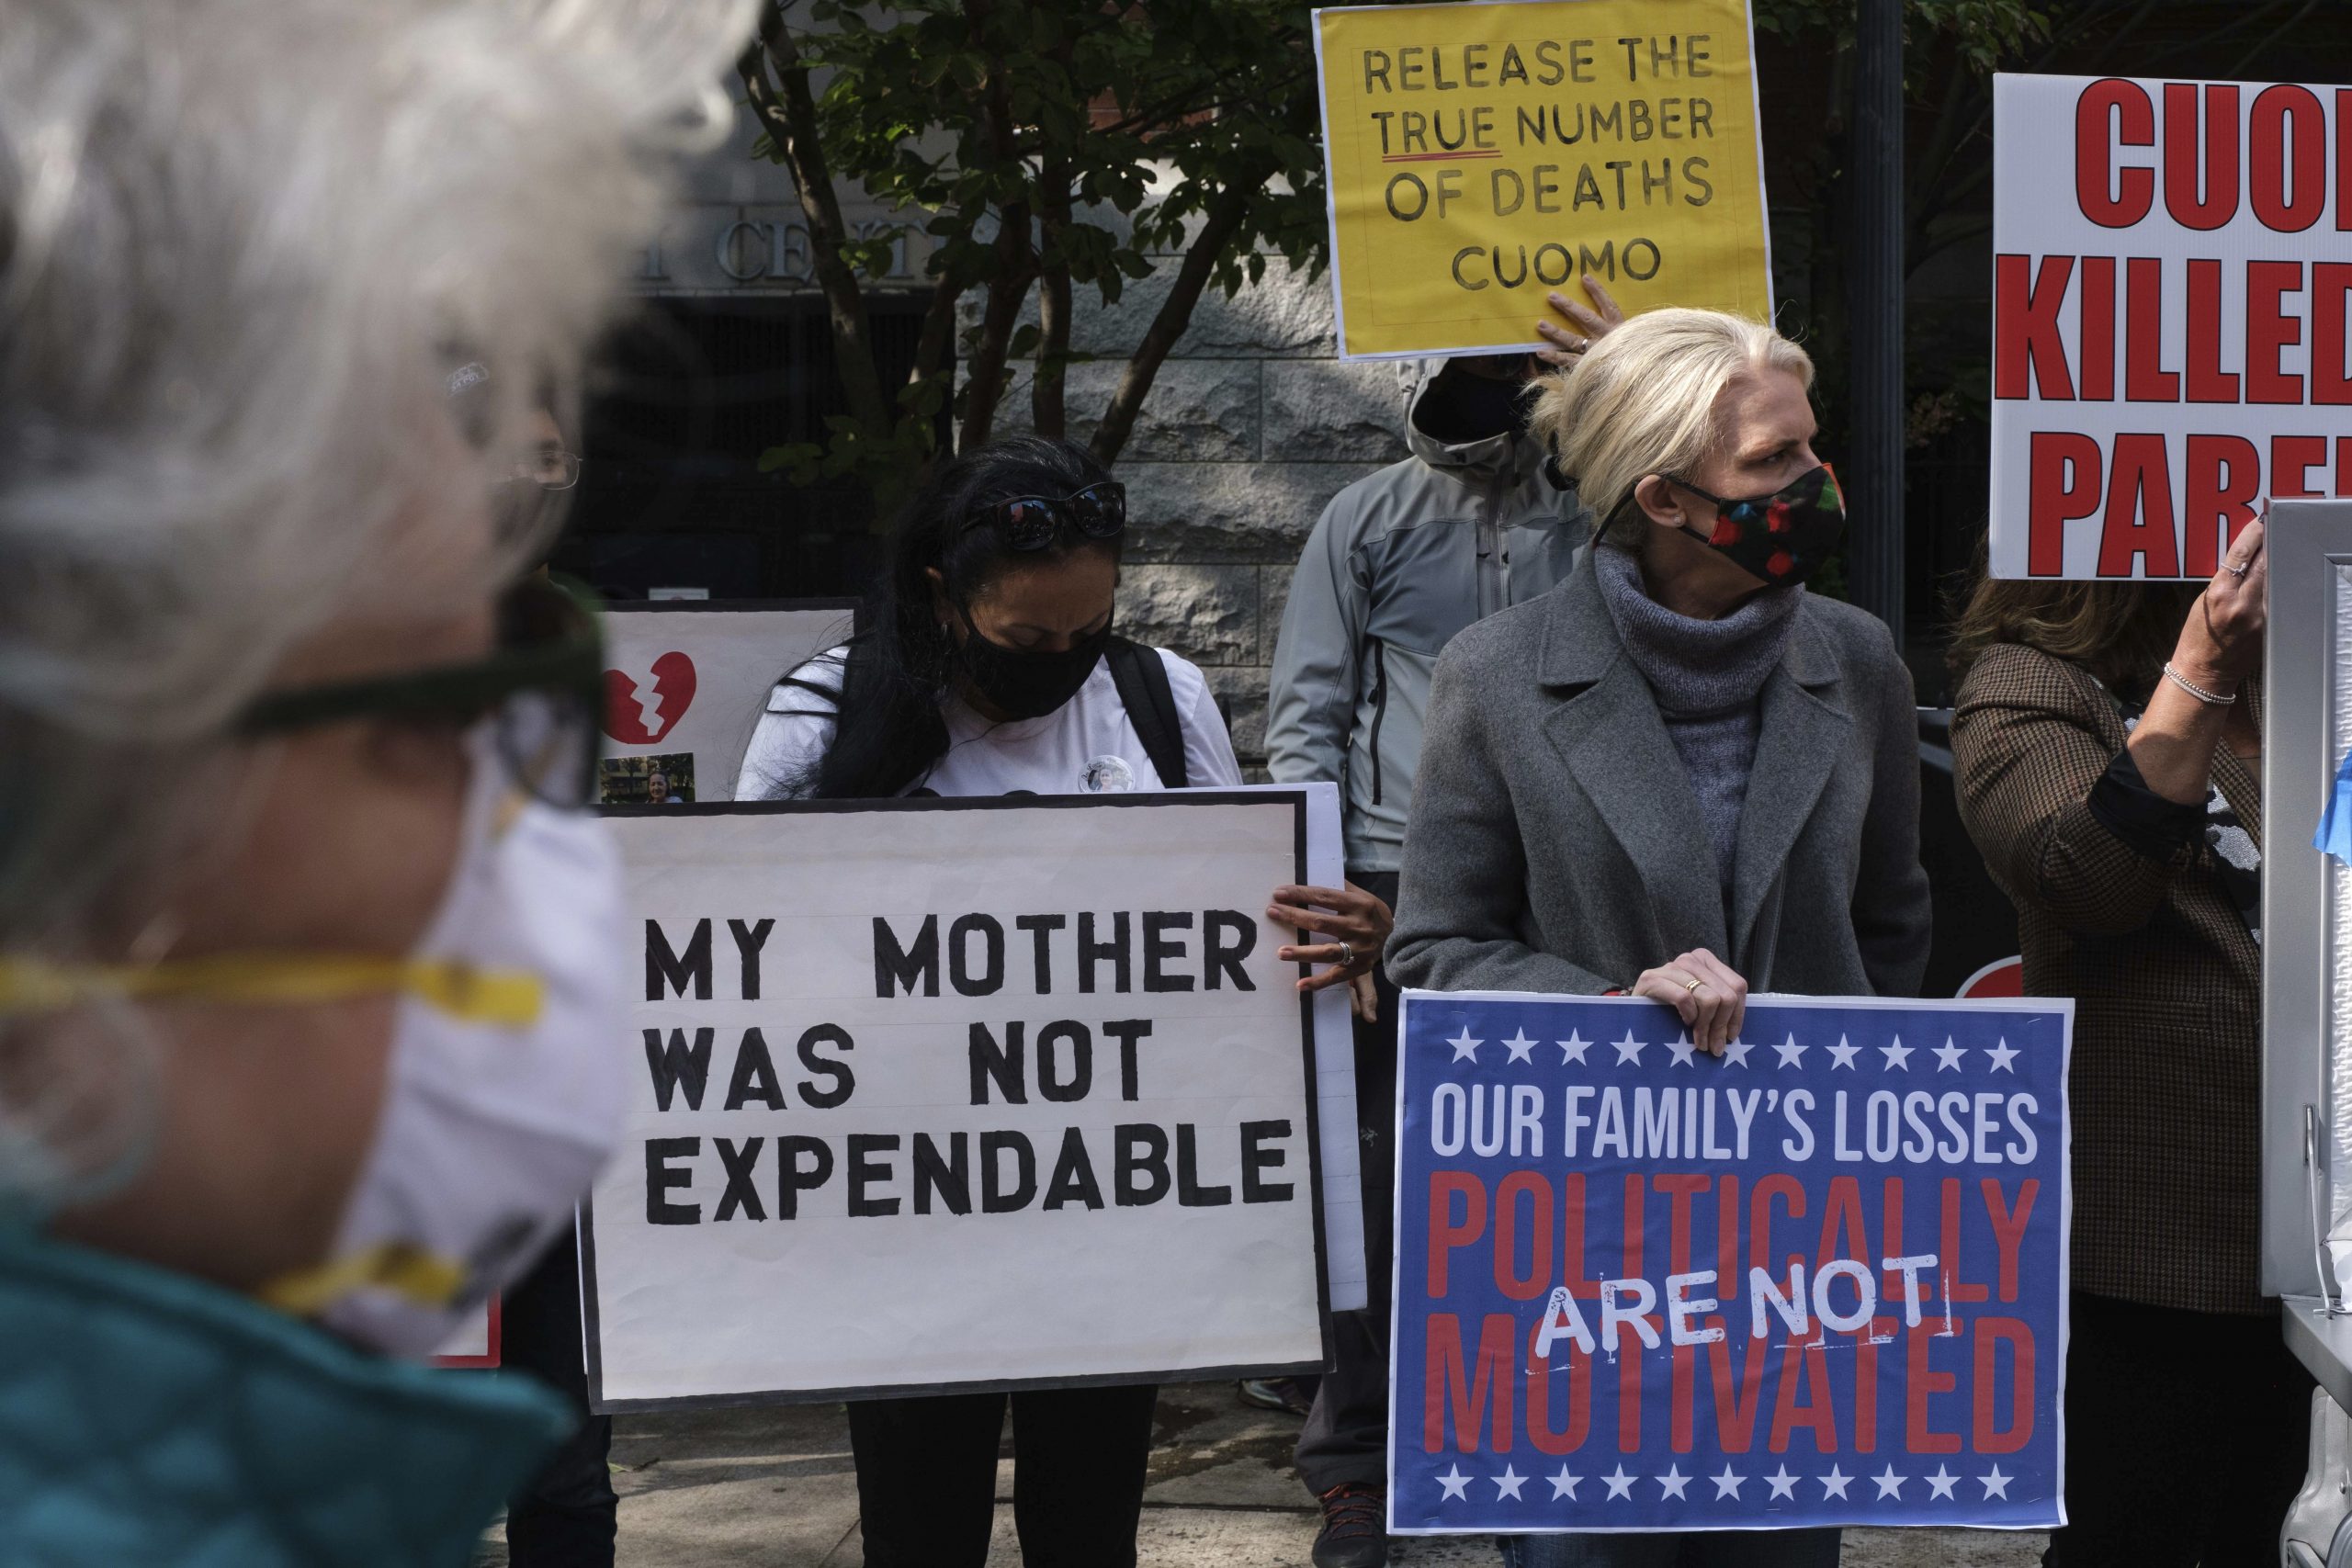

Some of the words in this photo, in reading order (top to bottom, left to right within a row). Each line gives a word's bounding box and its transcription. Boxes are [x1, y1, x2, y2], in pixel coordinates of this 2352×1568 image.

[1363, 39, 1596, 94] RELEASE
[1618, 34, 1713, 83] THE
[1370, 107, 1497, 154] TRUE
[1517, 97, 1713, 147] NUMBER
[2075, 78, 2352, 232] CUO
[1385, 169, 1464, 222] OF
[1491, 156, 1713, 217] DEATHS
[1452, 237, 1661, 291] CUOMO
[645, 918, 776, 1001] MY
[873, 908, 1258, 998] MOTHER
[641, 1022, 856, 1112] WAS
[967, 1019, 1153, 1106] NOT
[1430, 1082, 1544, 1157] OUR
[1565, 1086, 1815, 1162] FAMILY'S
[1834, 1089, 2039, 1165] LOSSES
[645, 1119, 1295, 1225] EXPENDABLE
[1427, 1170, 2041, 1303] POLITICALLY
[1534, 1269, 1725, 1359] ARE
[1424, 1313, 2035, 1455] MOTIVATED
